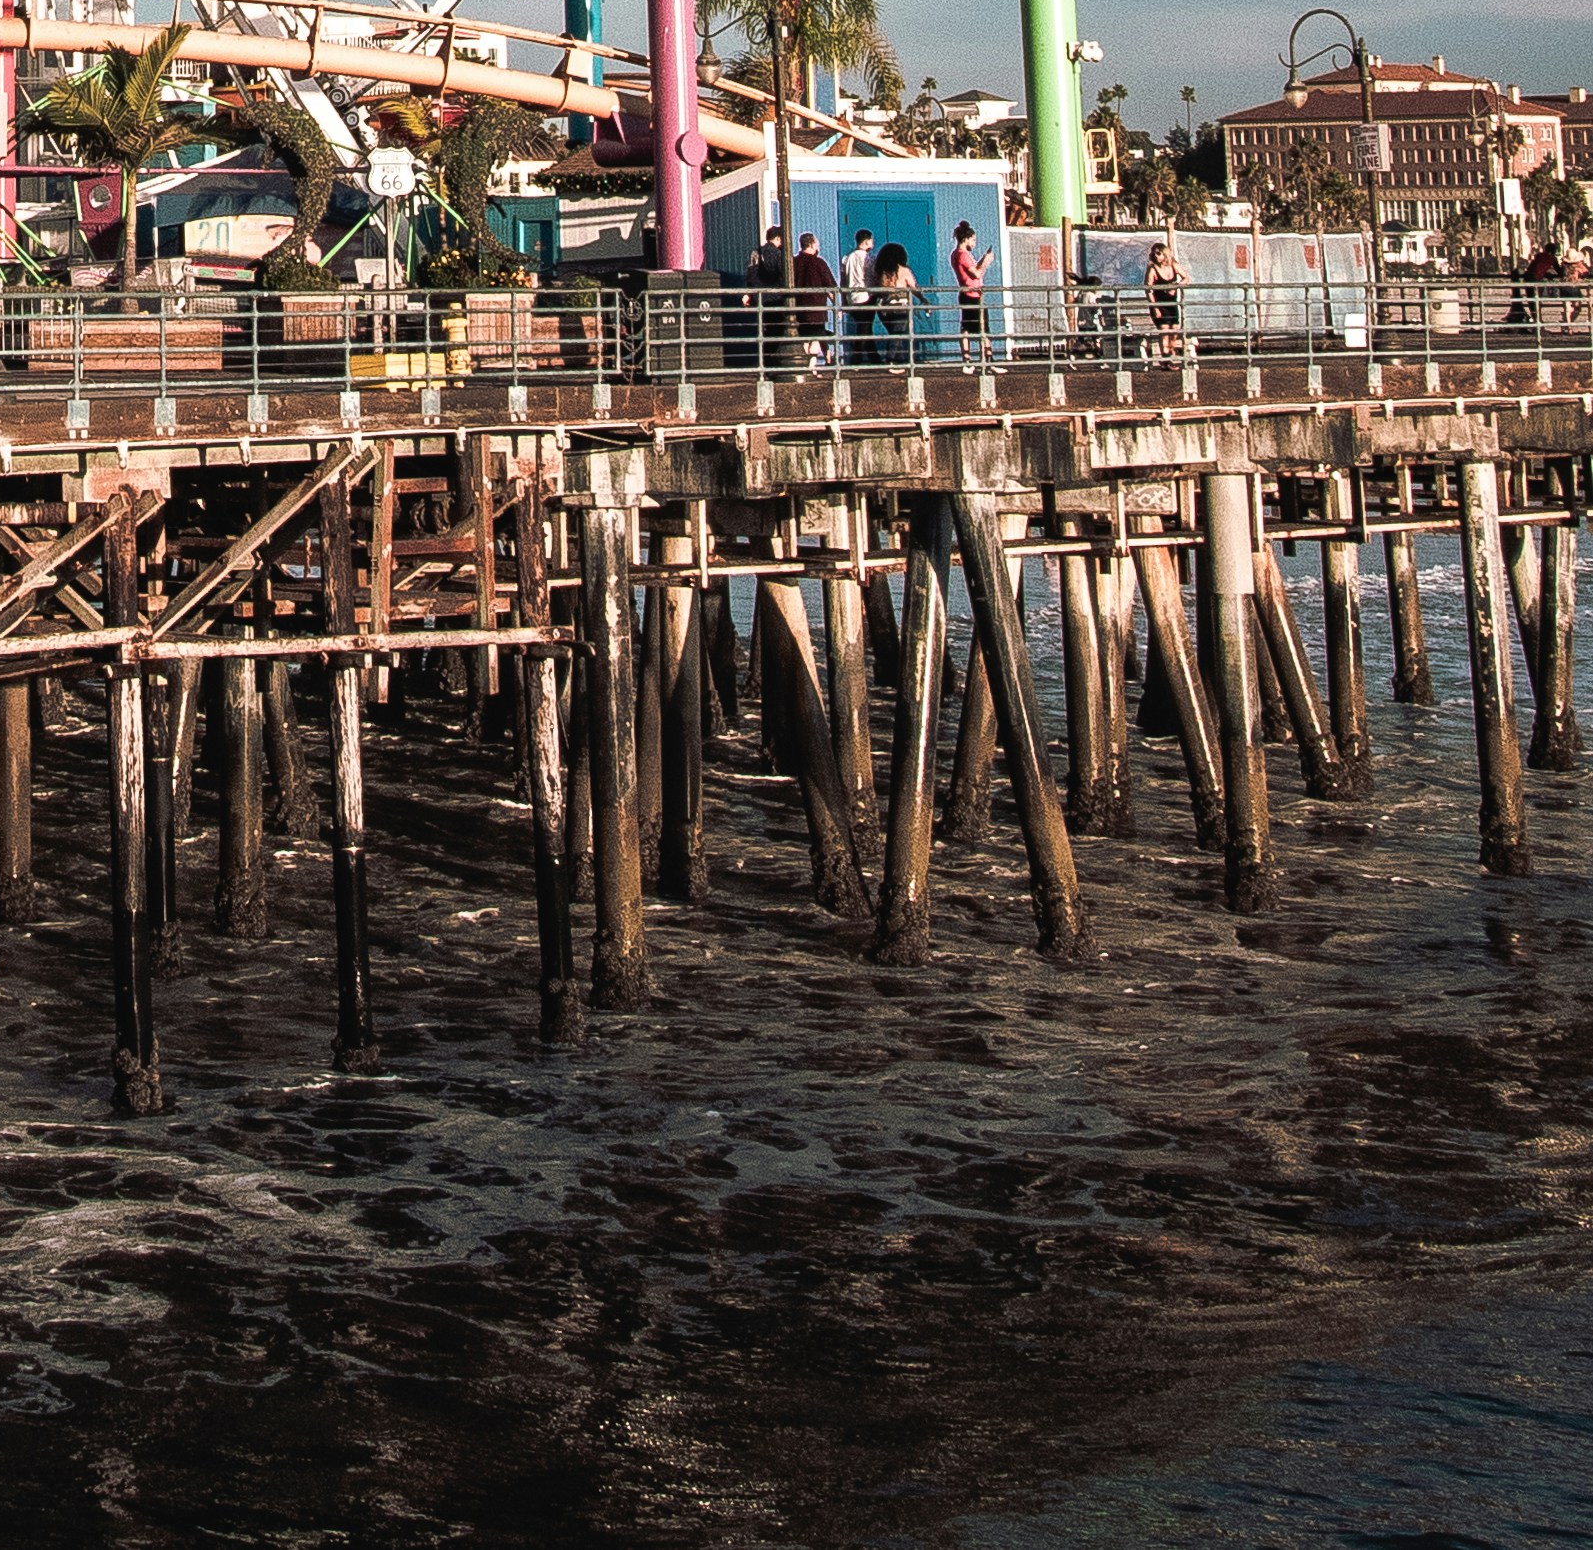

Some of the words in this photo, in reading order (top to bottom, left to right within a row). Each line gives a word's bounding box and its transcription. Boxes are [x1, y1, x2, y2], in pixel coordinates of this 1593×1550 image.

[1357, 144, 1377, 156] FIRE
[1357, 156, 1380, 169] LANE
[382, 175, 403, 190] 66
